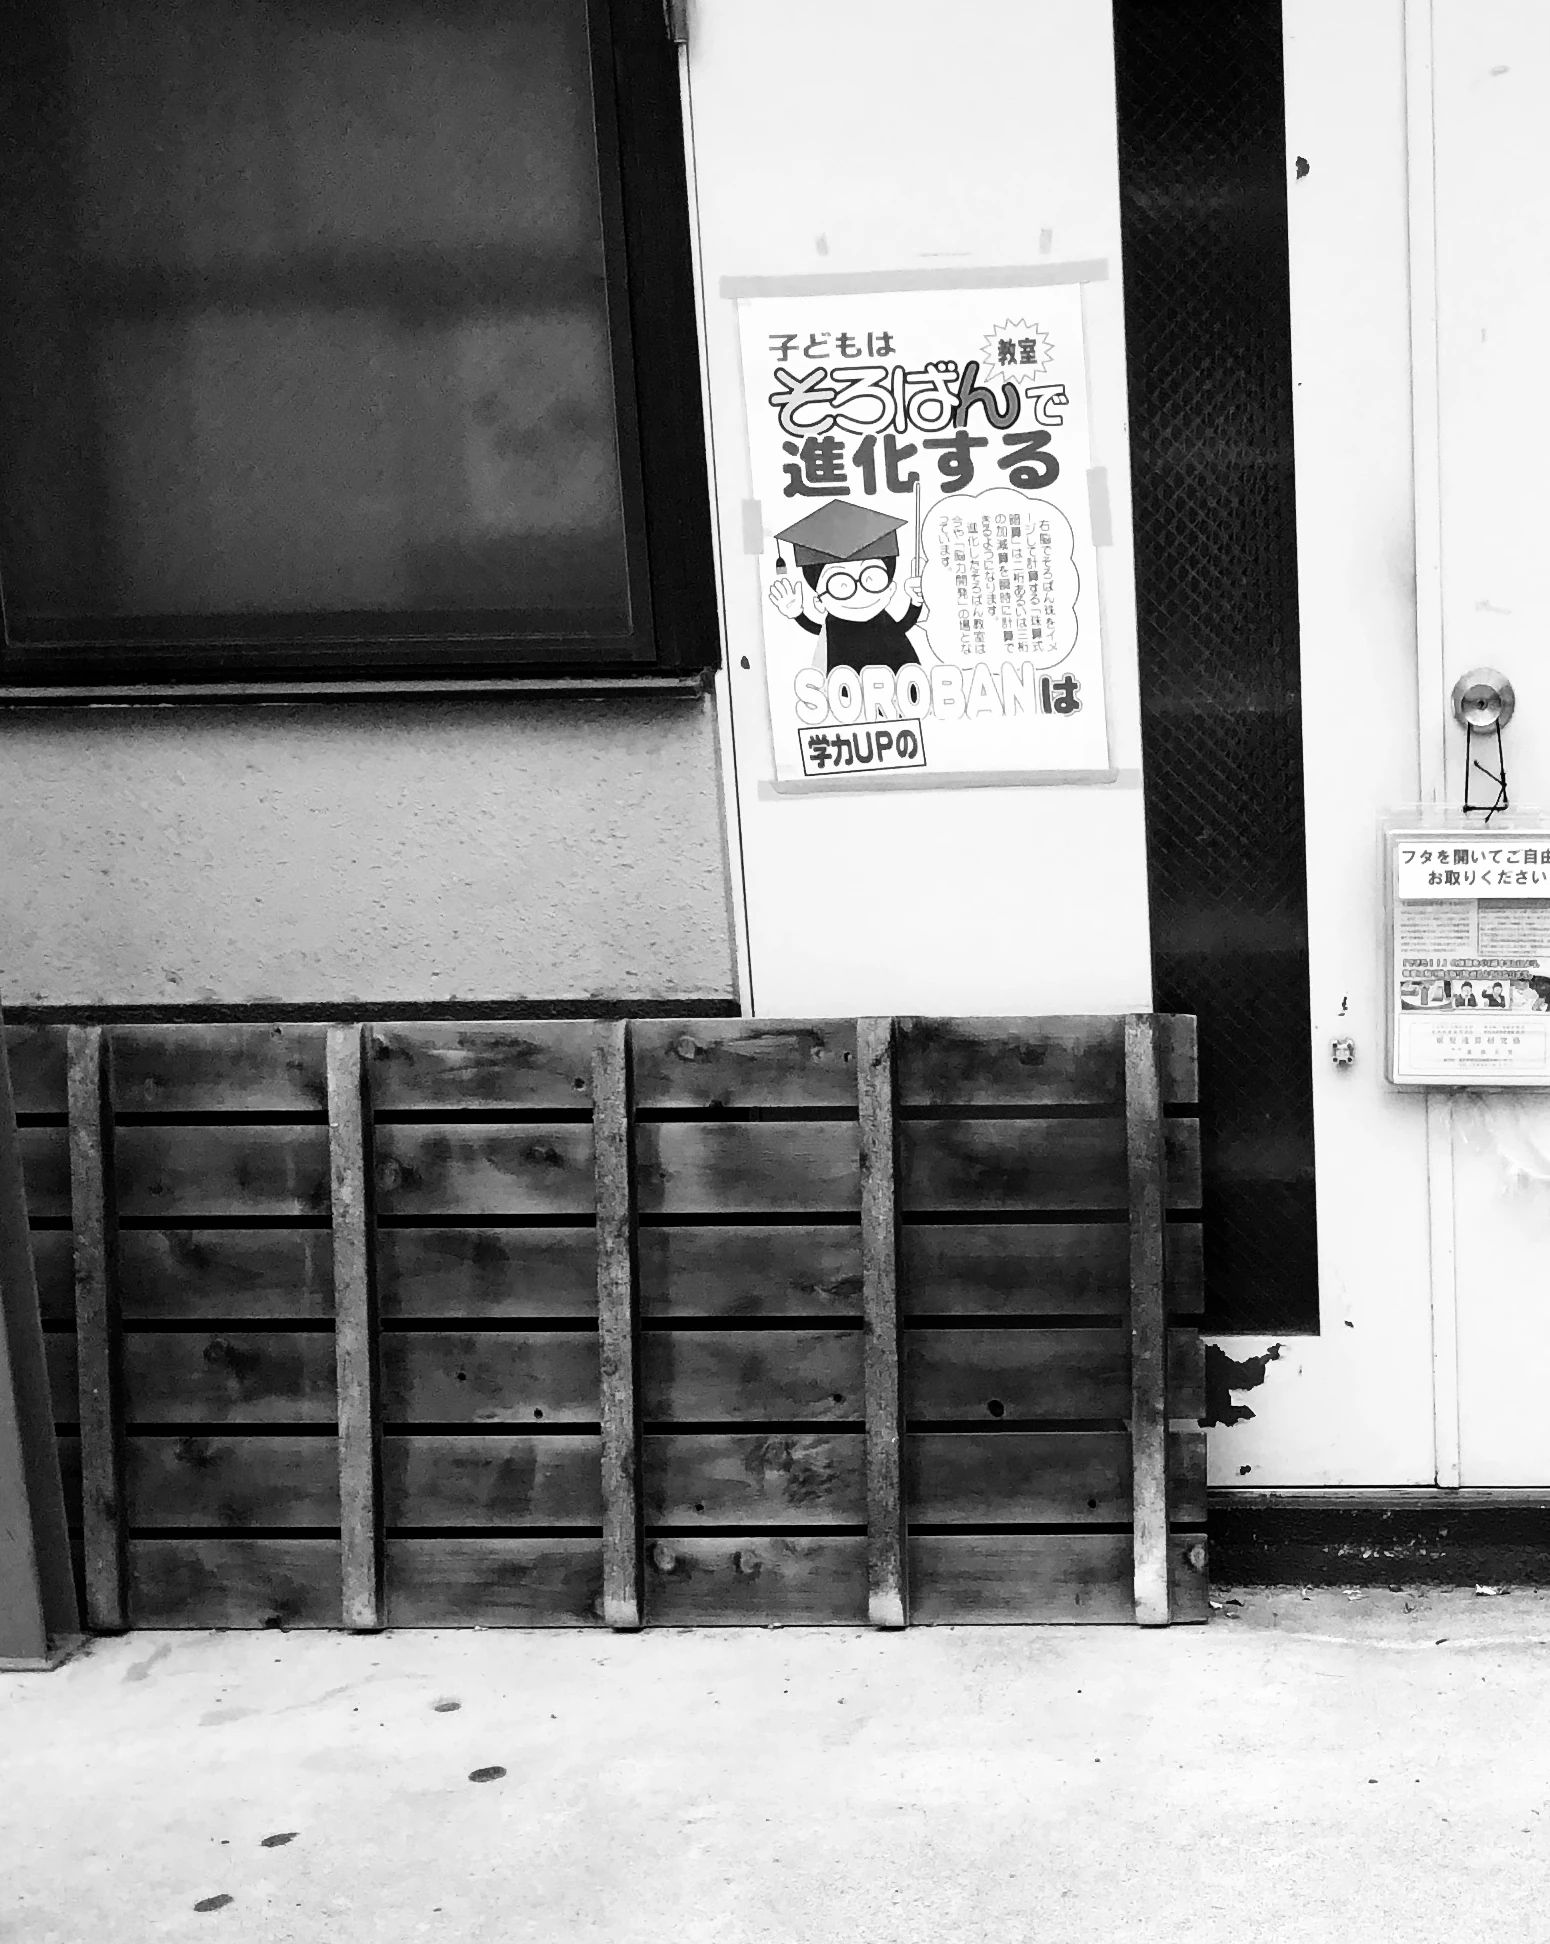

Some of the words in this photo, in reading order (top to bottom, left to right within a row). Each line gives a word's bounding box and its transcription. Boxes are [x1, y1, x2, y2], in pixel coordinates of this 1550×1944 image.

[768, 331, 895, 361] 子どもは
[997, 337, 1038, 366] 教室
[768, 360, 1069, 437] そろばんで
[782, 430, 1060, 496] 進化する
[808, 730, 919, 768] 学力UPの
[1428, 870, 1547, 885] お取りください
